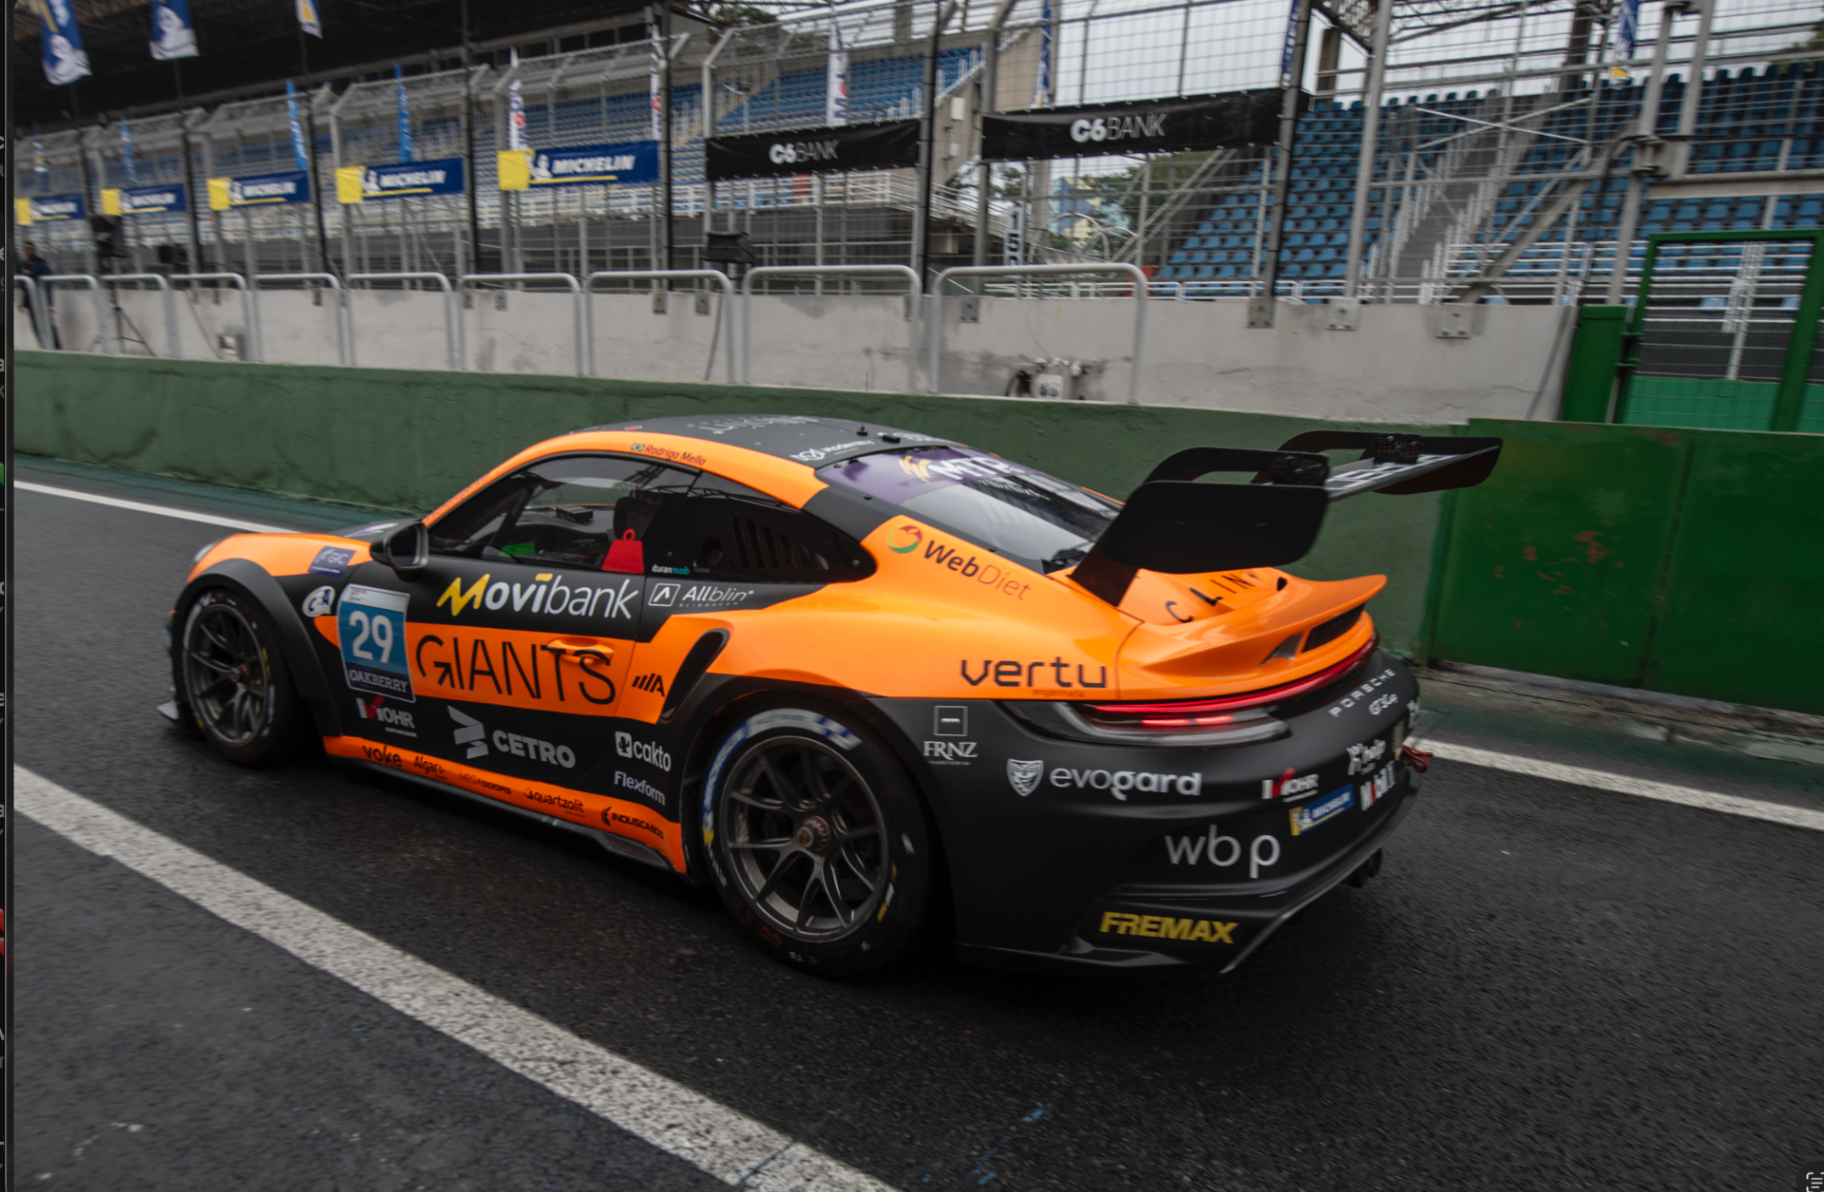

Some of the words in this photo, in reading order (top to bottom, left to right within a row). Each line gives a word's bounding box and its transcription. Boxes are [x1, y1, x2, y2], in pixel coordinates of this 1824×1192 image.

[380, 169, 446, 188] MICHELIN
[552, 155, 636, 174] MICHELIN
[644, 444, 680, 460] Rodrigo
[681, 452, 706, 466] Mello
[923, 540, 1032, 600] WebDiet
[436, 573, 640, 619] Movibank
[349, 610, 393, 664] 29
[349, 669, 408, 693] OAKBERRY
[416, 634, 617, 705] GIANTS
[961, 657, 1106, 688] vertu
[1328, 669, 1396, 717] PORSCHE
[362, 745, 403, 768] voke
[492, 730, 576, 769] CETRO
[633, 741, 672, 772] cakto
[923, 741, 978, 760] FRNZ
[614, 771, 666, 806] Flexform
[1049, 767, 1202, 800] evogard
[533, 791, 585, 814] quartzolit
[611, 812, 664, 840] INDUSCABOS
[1165, 825, 1281, 879] wbp
[1100, 911, 1240, 944] FREMAX
